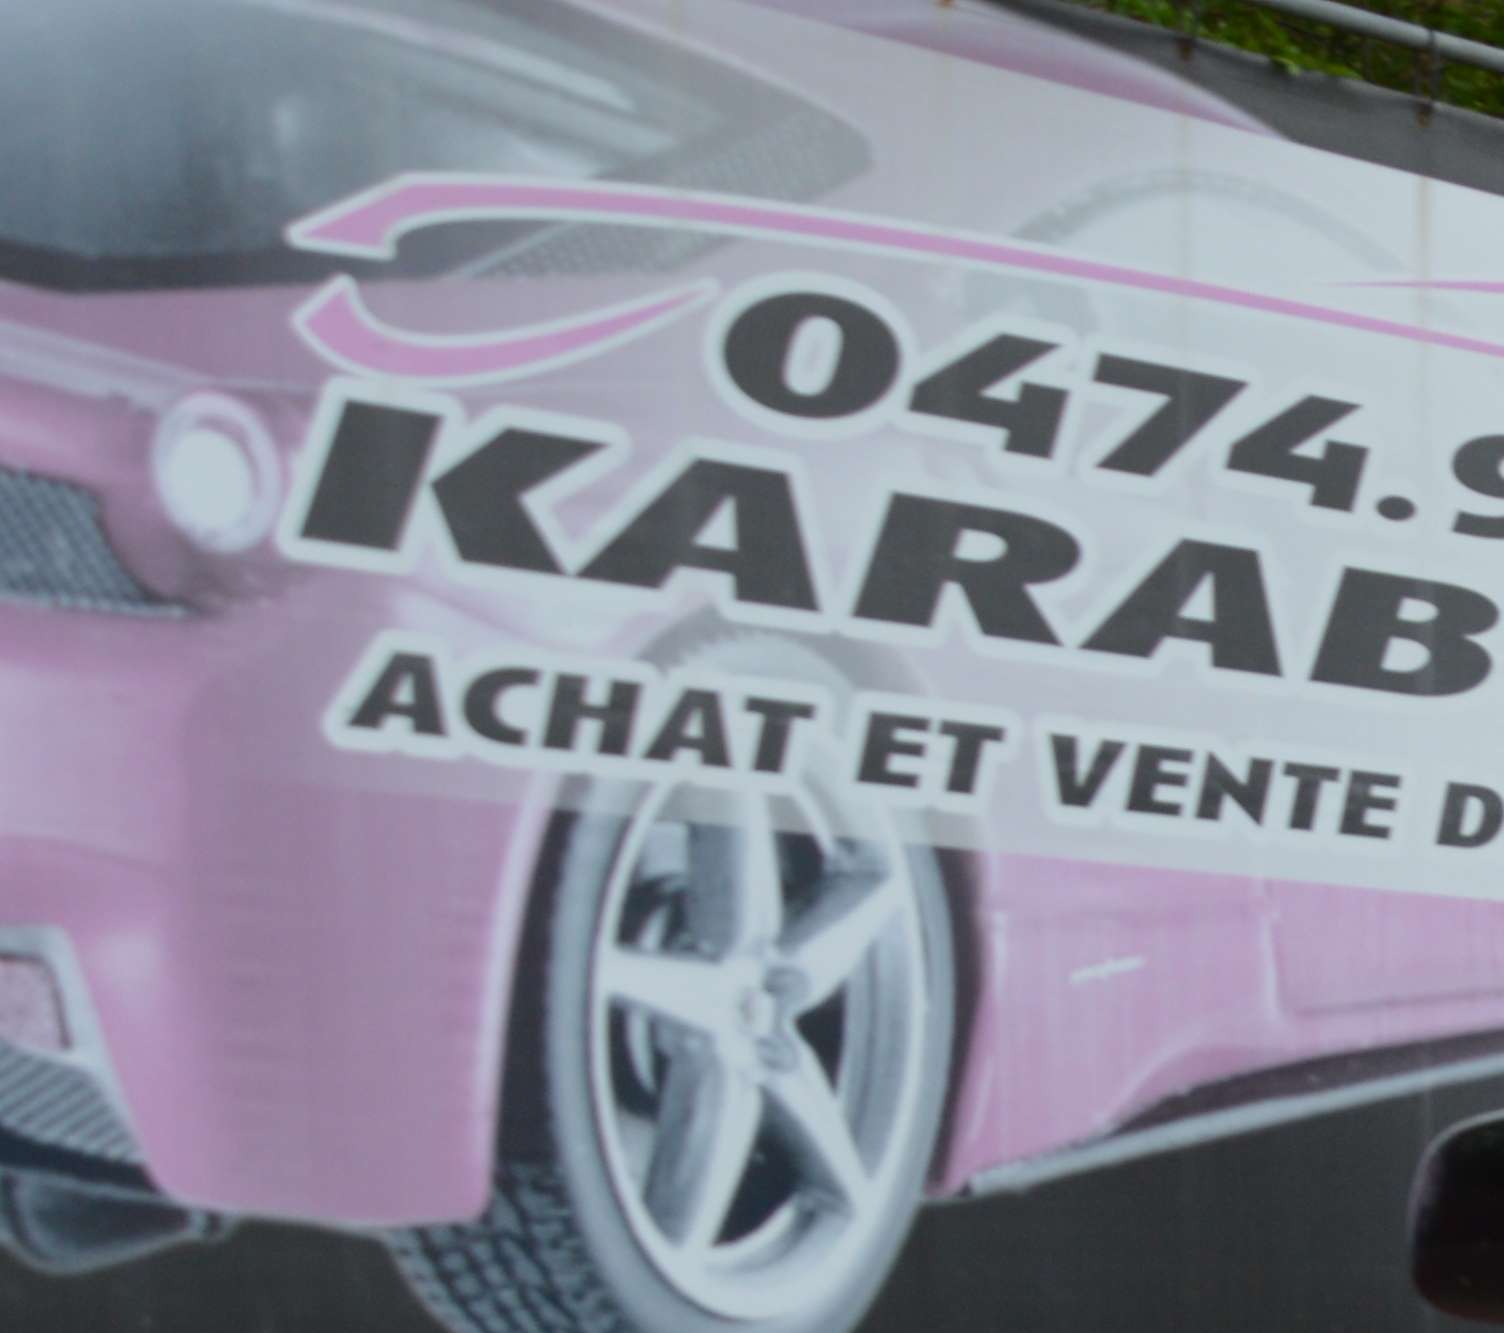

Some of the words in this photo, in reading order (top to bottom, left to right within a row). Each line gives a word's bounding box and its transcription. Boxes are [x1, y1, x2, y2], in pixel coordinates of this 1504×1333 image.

[347, 651, 818, 775] ACHAT
[854, 710, 1005, 795] ET
[1048, 731, 1405, 840] VENTE
